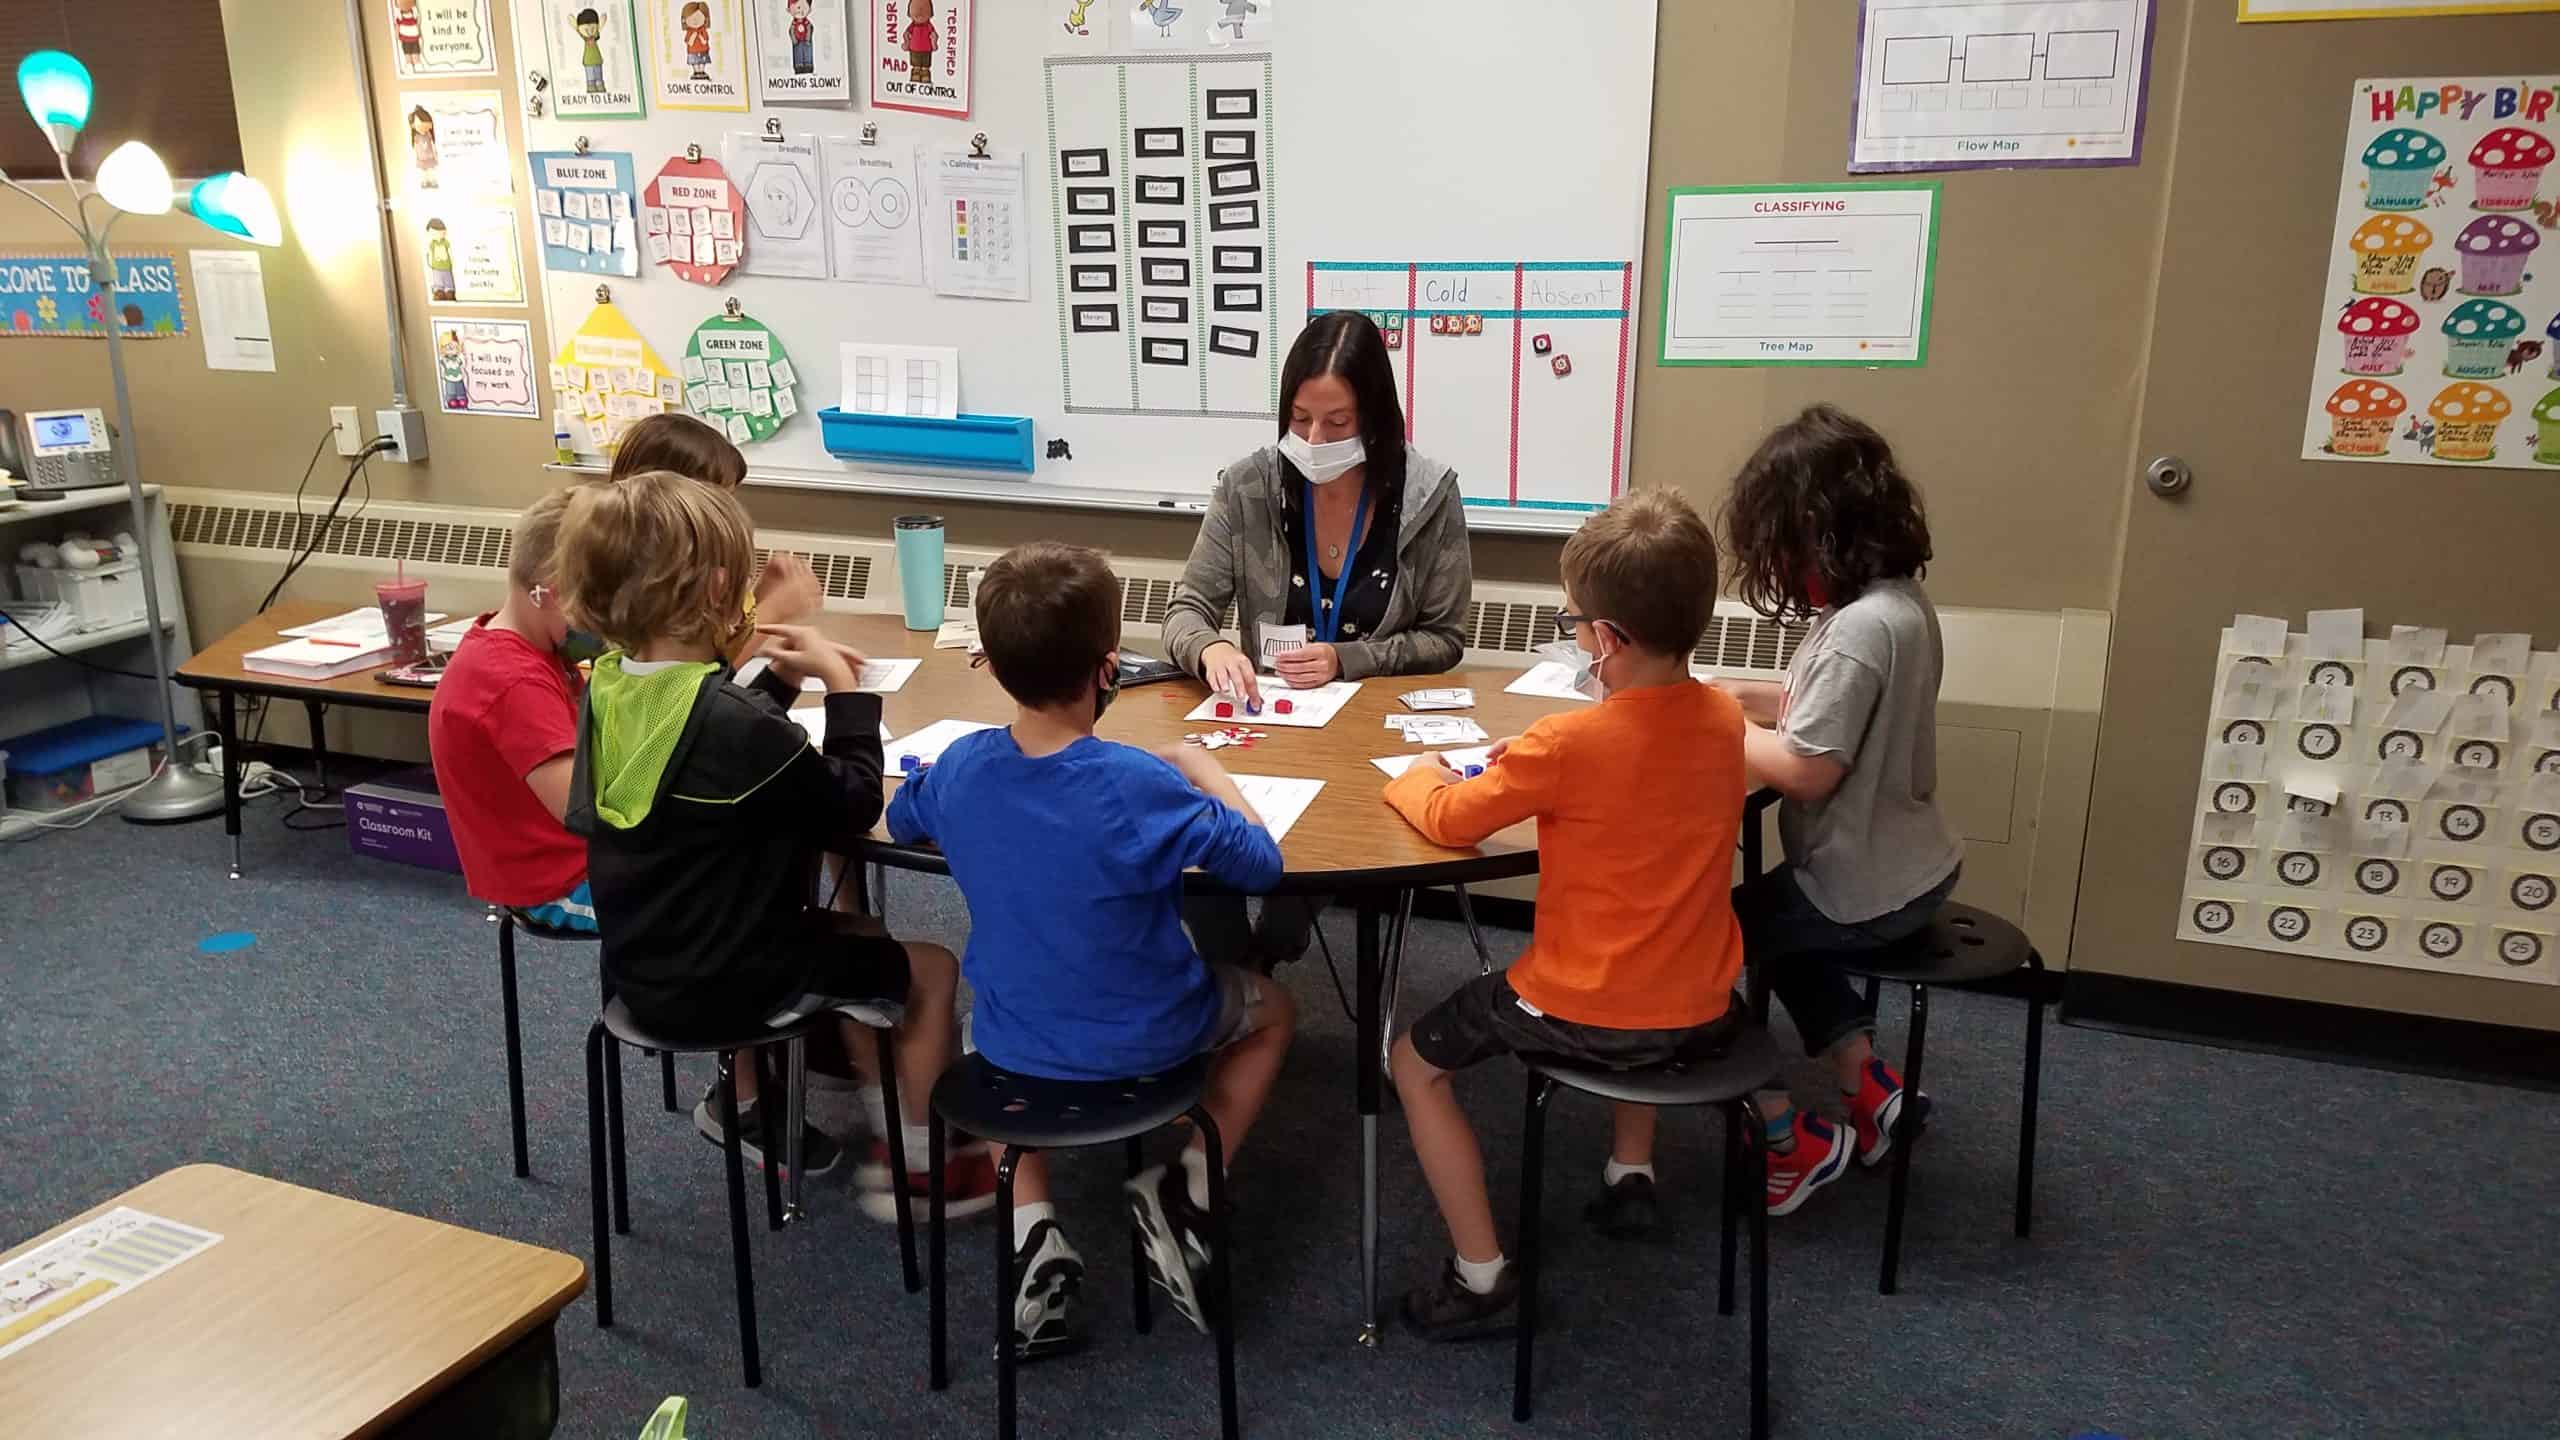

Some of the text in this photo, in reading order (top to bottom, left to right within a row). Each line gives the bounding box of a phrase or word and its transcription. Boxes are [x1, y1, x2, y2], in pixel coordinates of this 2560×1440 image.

[435, 8, 451, 19] will
[456, 8, 468, 18] be
[432, 24, 466, 34] kind to
[429, 42, 472, 52] everyone.
[946, 8, 957, 77] TERRIFIED
[882, 57, 908, 72] MAD
[768, 75, 841, 88] MOVING SLOWLY
[666, 83, 734, 95] SOME CONTROL
[886, 81, 957, 98] OUT OF CONTROL
[562, 92, 631, 105] READY TO LEARN
[2370, 85, 2488, 122] HAPPY
[778, 145, 811, 155] Breathing
[1957, 140, 2020, 151] Flow Map
[858, 158, 892, 168] Breathing
[949, 160, 979, 170] Calming
[556, 167, 607, 179] BLUE ZONE
[672, 186, 717, 198] RED ZONE
[1753, 200, 1845, 213] CLASSIFYING
[2371, 196, 2421, 206] JANUARY
[0, 265, 173, 294] COME TO LASS
[1425, 277, 1469, 304] Cold
[1530, 278, 1615, 307] Absent
[705, 339, 763, 350] GREEN ZONE
[1758, 341, 1813, 352] Tree Map
[477, 352, 491, 362] will
[494, 353, 512, 365] stay
[471, 365, 515, 378] focused on
[475, 380, 512, 391] my work.
[2325, 673, 2336, 686] 2
[2237, 730, 2249, 743] 6
[2313, 734, 2325, 747] 7
[2469, 751, 2481, 764] 9
[2228, 793, 2240, 806] 11
[2303, 800, 2316, 812] 12
[359, 817, 432, 841] Classroom Kit
[2454, 816, 2471, 829] 14
[2537, 825, 2552, 838] 15
[2216, 855, 2231, 868] 16
[2290, 862, 2305, 875] 17
[2369, 869, 2384, 882] 18
[2442, 876, 2458, 889] 19
[2521, 886, 2544, 899] 20
[2205, 910, 2221, 922] 21
[2278, 917, 2297, 930] 22
[2356, 926, 2375, 940] 23
[2430, 933, 2450, 946] 24
[2509, 941, 2529, 954] 25
